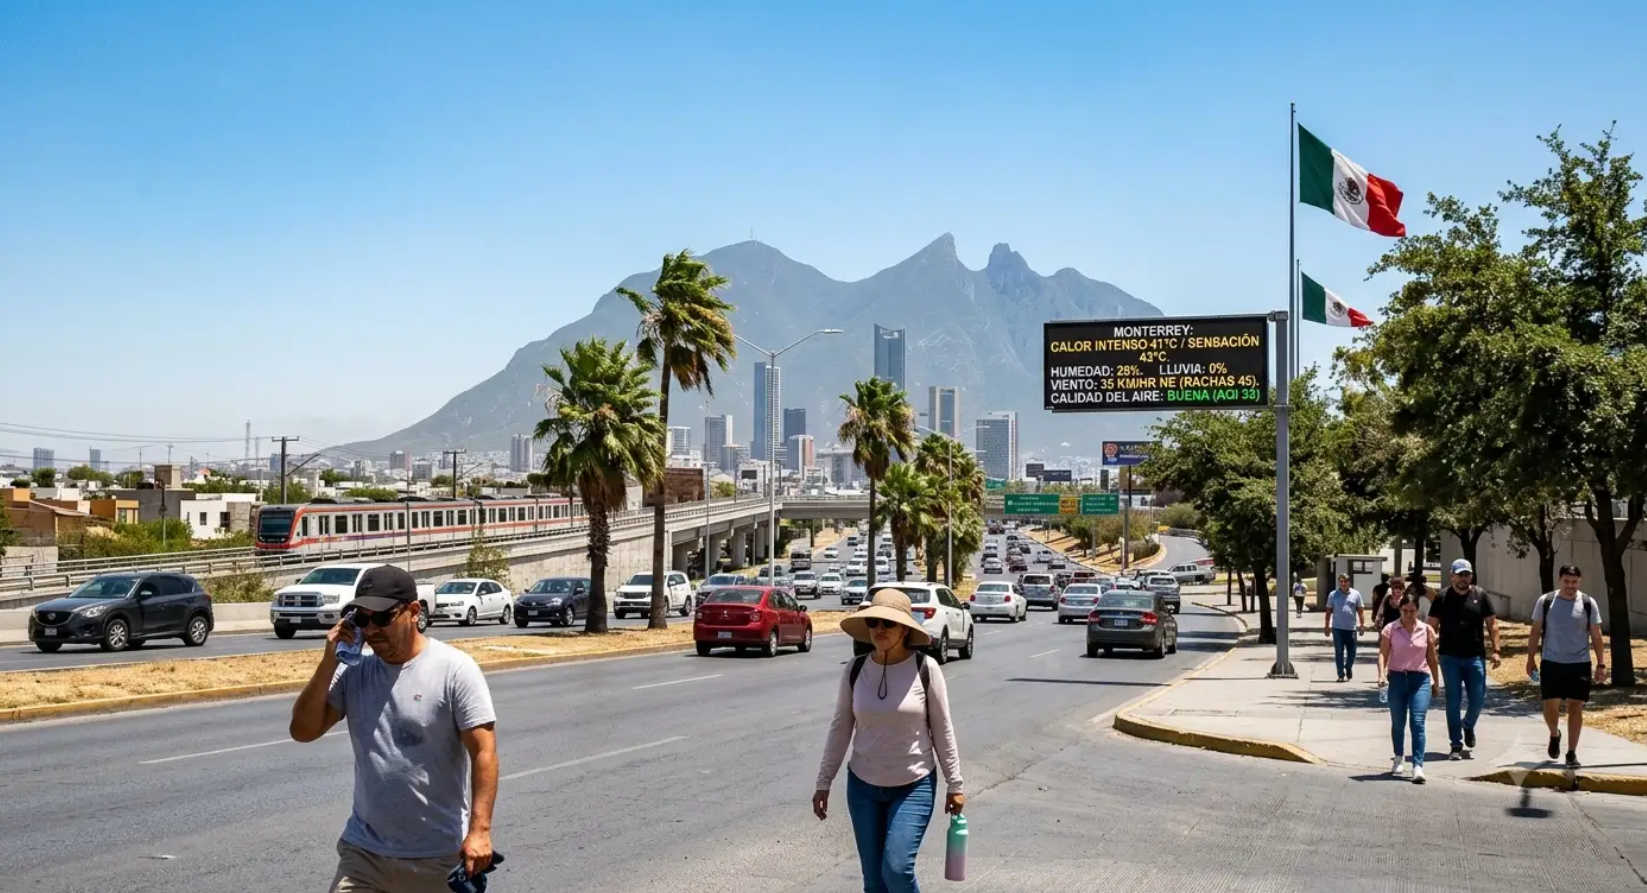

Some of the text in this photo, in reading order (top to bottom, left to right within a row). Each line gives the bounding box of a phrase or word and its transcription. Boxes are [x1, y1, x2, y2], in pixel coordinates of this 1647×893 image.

[1114, 324, 1194, 338] MONTERREY:
[1050, 340, 1092, 353] CALOR
[1095, 339, 1148, 352] INTENSO
[1180, 337, 1186, 349] /
[1139, 350, 1170, 363] 43°C.
[1051, 365, 1114, 378] HUMEDAD:
[1159, 363, 1206, 375] LLUVIA:
[1209, 362, 1227, 374] 0%
[1050, 378, 1098, 391] VIENTO:
[1100, 378, 1115, 390] 35
[1159, 376, 1176, 388] NE
[1179, 376, 1235, 390] (RACHAS
[1237, 375, 1260, 389] 45).
[1050, 392, 1103, 404] CALIDAD
[1106, 391, 1130, 403] DEL
[1132, 390, 1164, 402] AIRE:
[1167, 389, 1210, 401] BUENA
[1212, 389, 1238, 403] (AQI
